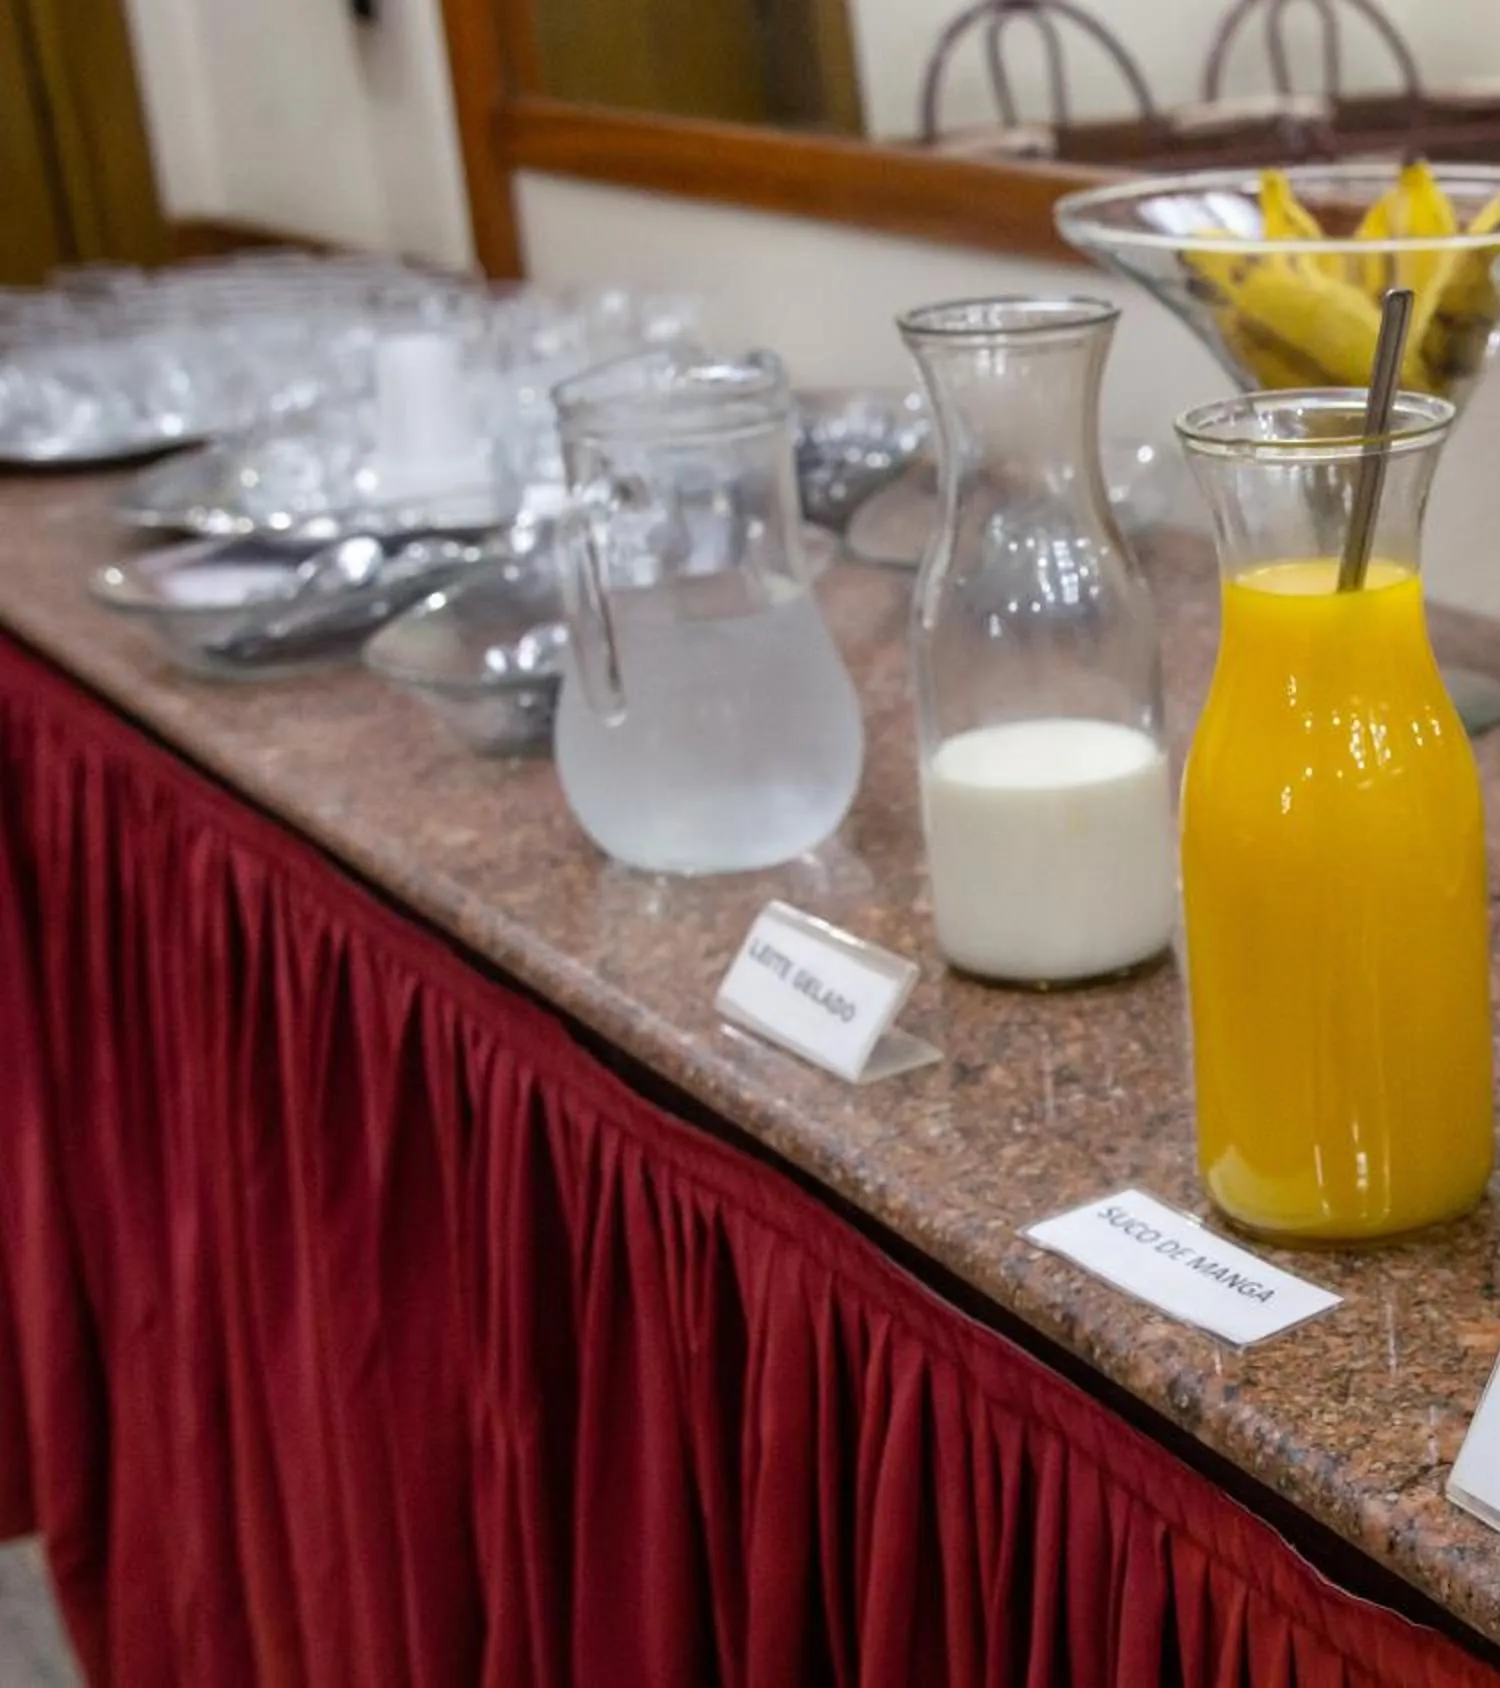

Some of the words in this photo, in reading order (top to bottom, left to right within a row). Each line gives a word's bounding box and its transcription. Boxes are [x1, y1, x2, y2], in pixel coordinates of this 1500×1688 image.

[749, 937, 795, 981] LEITE
[792, 968, 857, 1023] GELADO
[1097, 1205, 1160, 1244] SUCO
[1155, 1238, 1190, 1261] DE
[1186, 1254, 1276, 1304] MANGA
